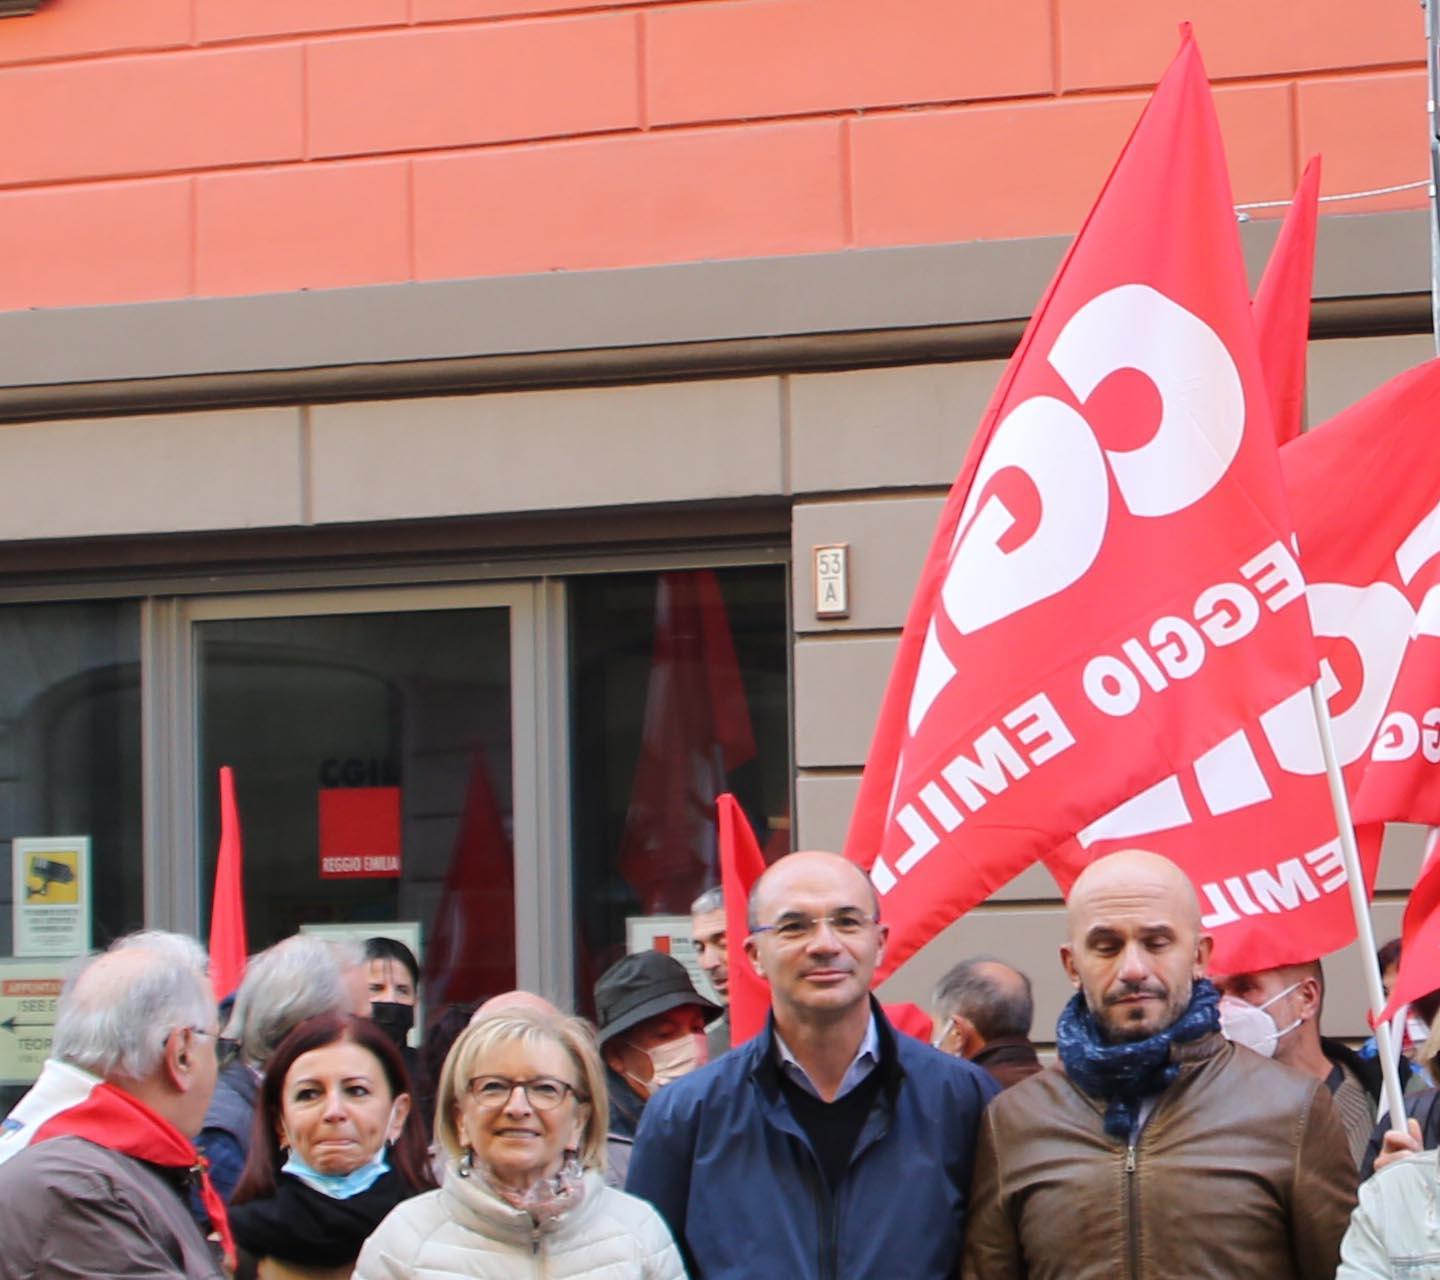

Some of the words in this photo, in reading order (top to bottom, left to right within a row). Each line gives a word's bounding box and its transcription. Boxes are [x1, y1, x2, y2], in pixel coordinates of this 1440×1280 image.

[819, 552, 841, 575] 53
[824, 581, 838, 602] A
[323, 856, 362, 873] REGGIO
[363, 855, 400, 872] EMILIA
